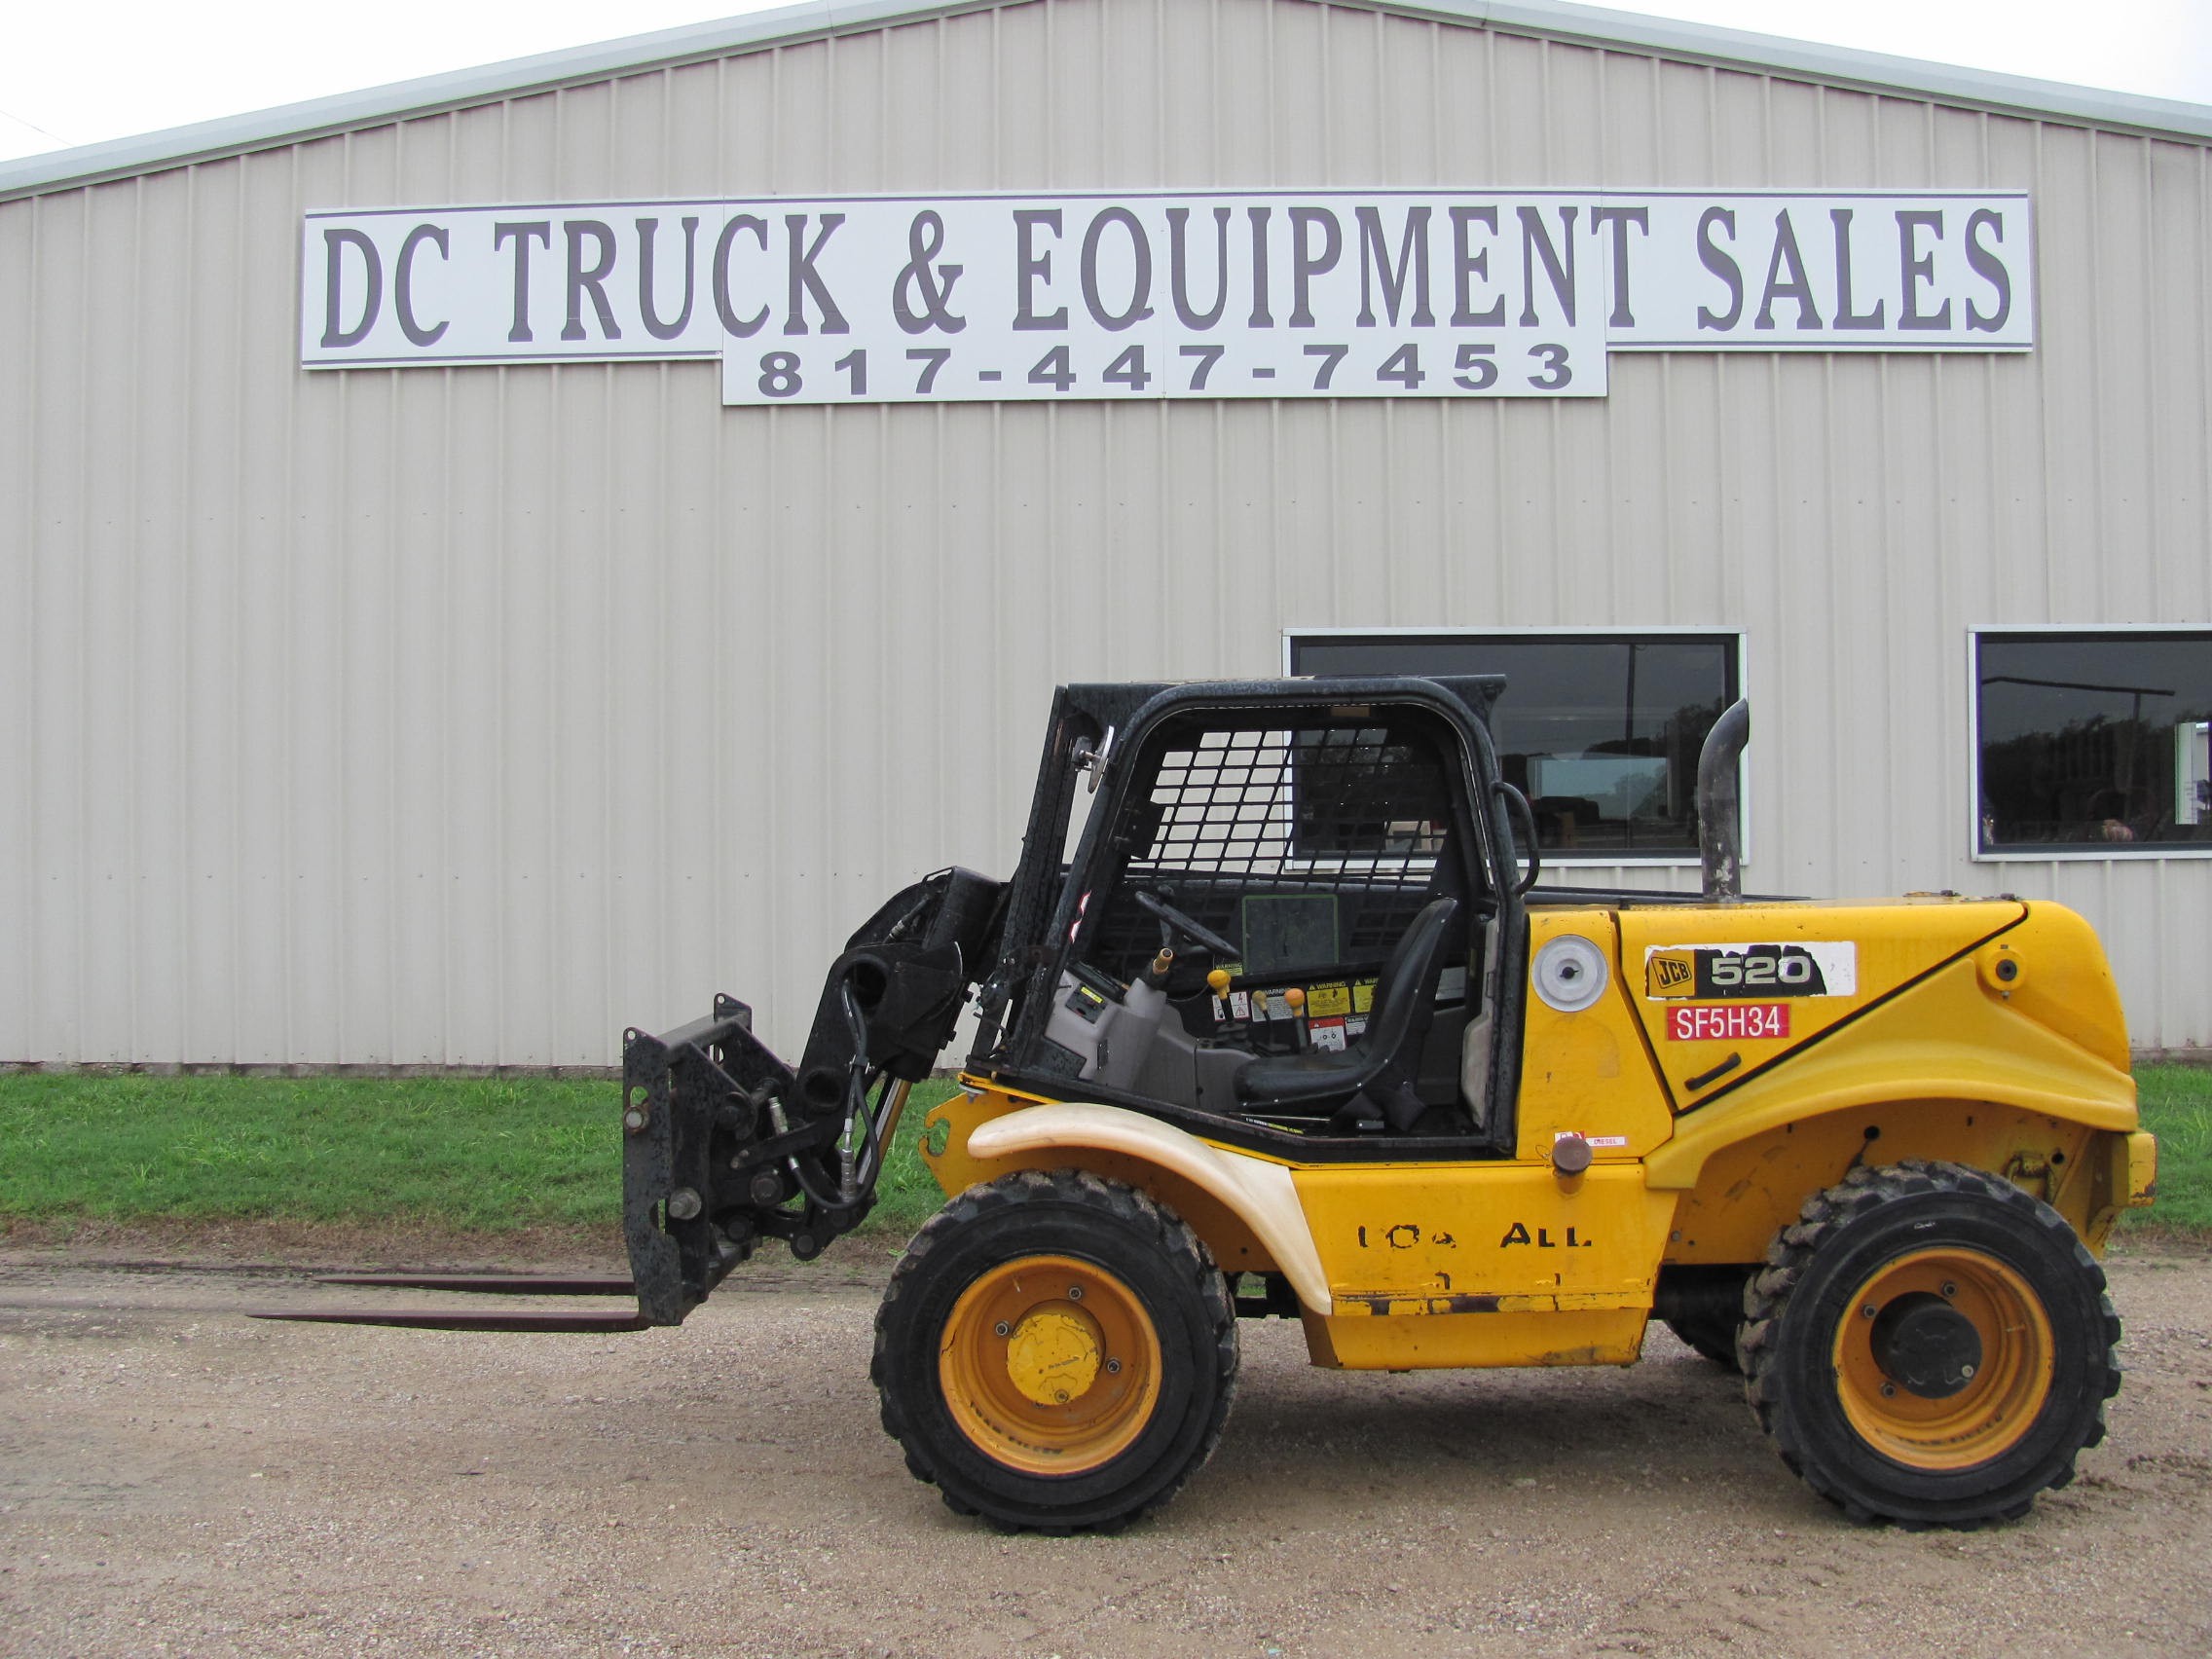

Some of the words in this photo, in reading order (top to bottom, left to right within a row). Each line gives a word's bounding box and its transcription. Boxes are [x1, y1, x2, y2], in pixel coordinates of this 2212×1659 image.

[320, 224, 450, 349] DC
[494, 212, 850, 343] TRUCK
[892, 208, 968, 335] &
[1013, 205, 1650, 334] EQUIPMENT
[1697, 205, 2012, 334] SALES
[757, 343, 1573, 398] 817-447-7453
[1316, 981, 1346, 990] WARNING
[1659, 960, 1690, 984] JCB
[1712, 955, 1811, 985] 520
[1677, 1006, 1781, 1039] SF5H34
